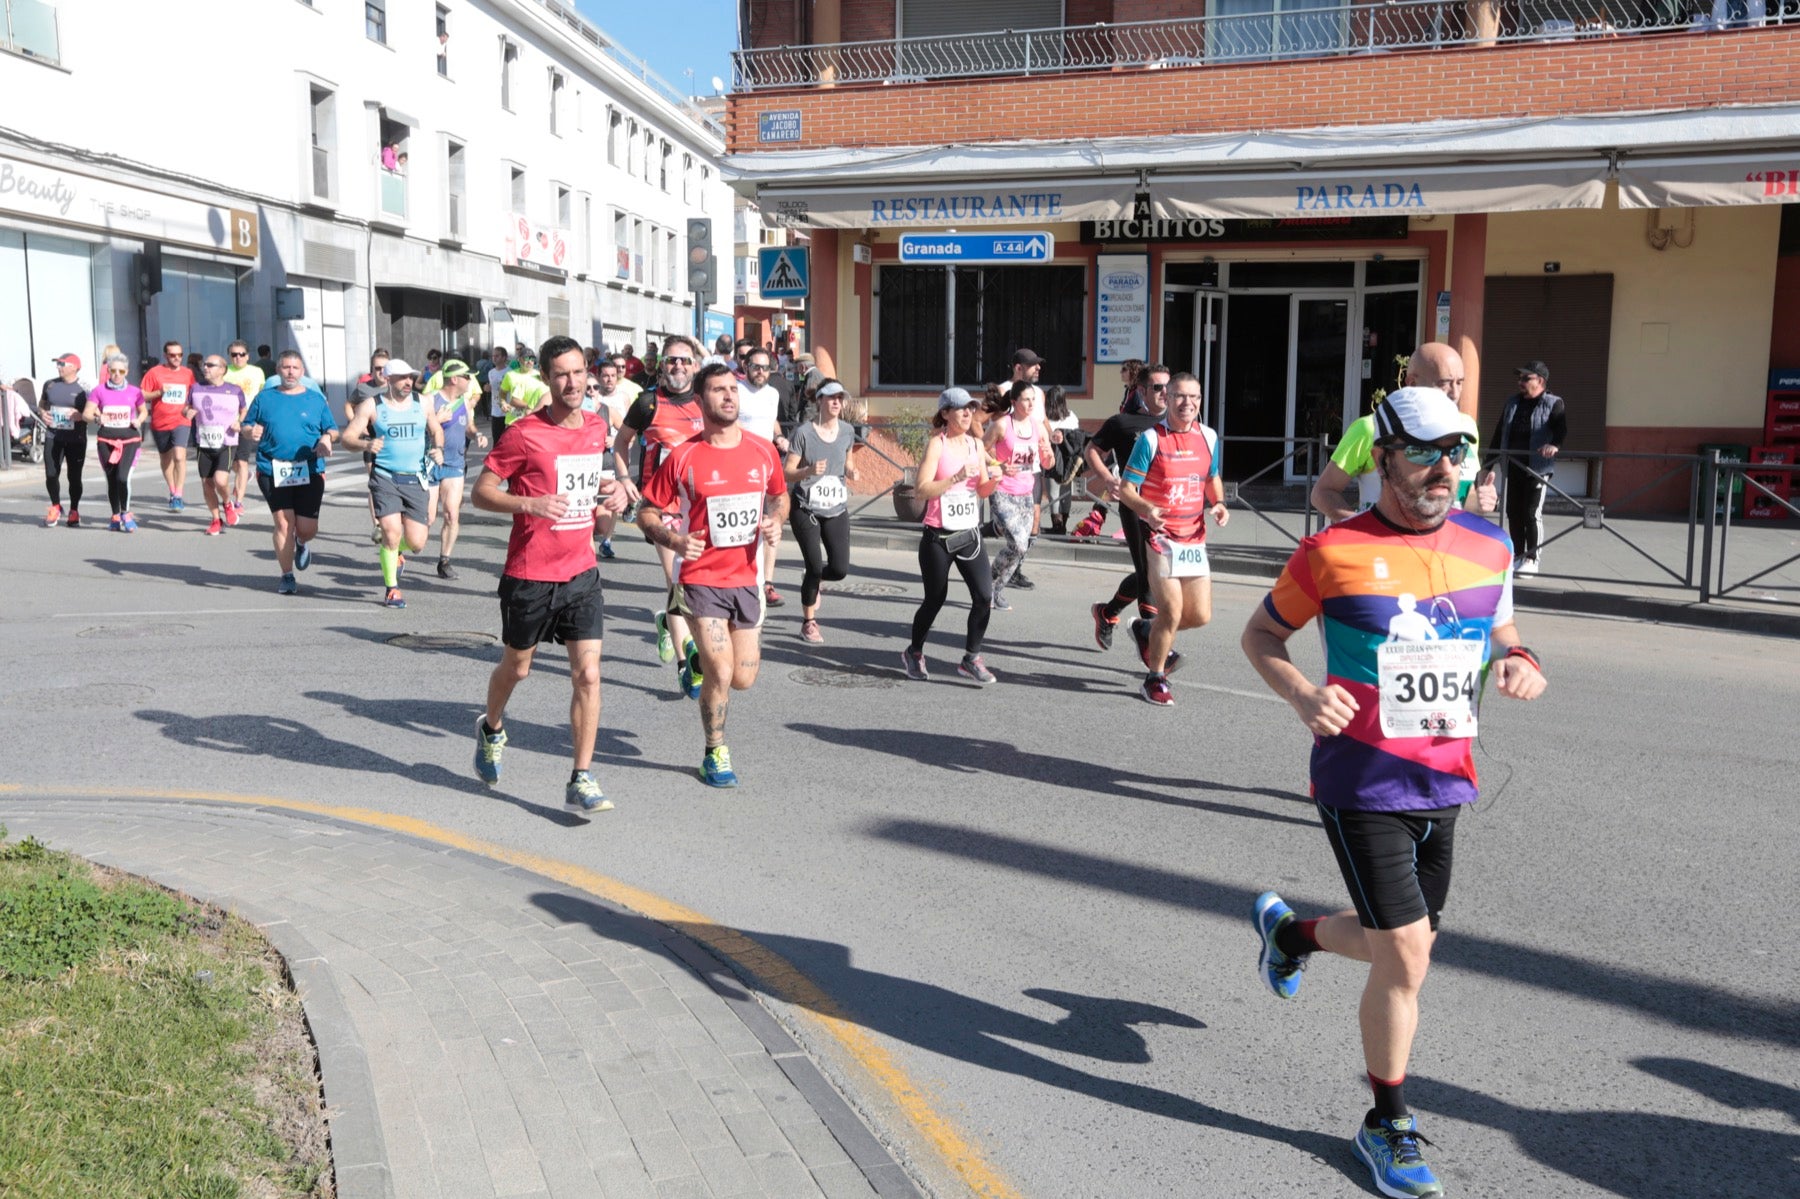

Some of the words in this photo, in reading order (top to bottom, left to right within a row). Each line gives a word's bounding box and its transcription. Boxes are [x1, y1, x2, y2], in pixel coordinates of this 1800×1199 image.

[769, 112, 799, 120] AVENIDA
[771, 120, 797, 130] JACOBO
[761, 130, 799, 140] CAMARERO
[0, 163, 76, 216] Beauty
[1295, 182, 1426, 210] PARADA
[90, 198, 115, 214] THE
[120, 204, 152, 220] SHOP
[872, 193, 1063, 222] RESTAURANTE
[238, 219, 251, 248] B
[1094, 218, 1226, 239] BICHITOS
[903, 242, 963, 255] Granada
[166, 390, 183, 398] 982
[279, 466, 303, 478] 677
[815, 485, 843, 498] 3011
[947, 502, 975, 517] 3057
[716, 508, 758, 529] 3032
[1178, 549, 1202, 563] 408
[1394, 671, 1475, 703] 3054
